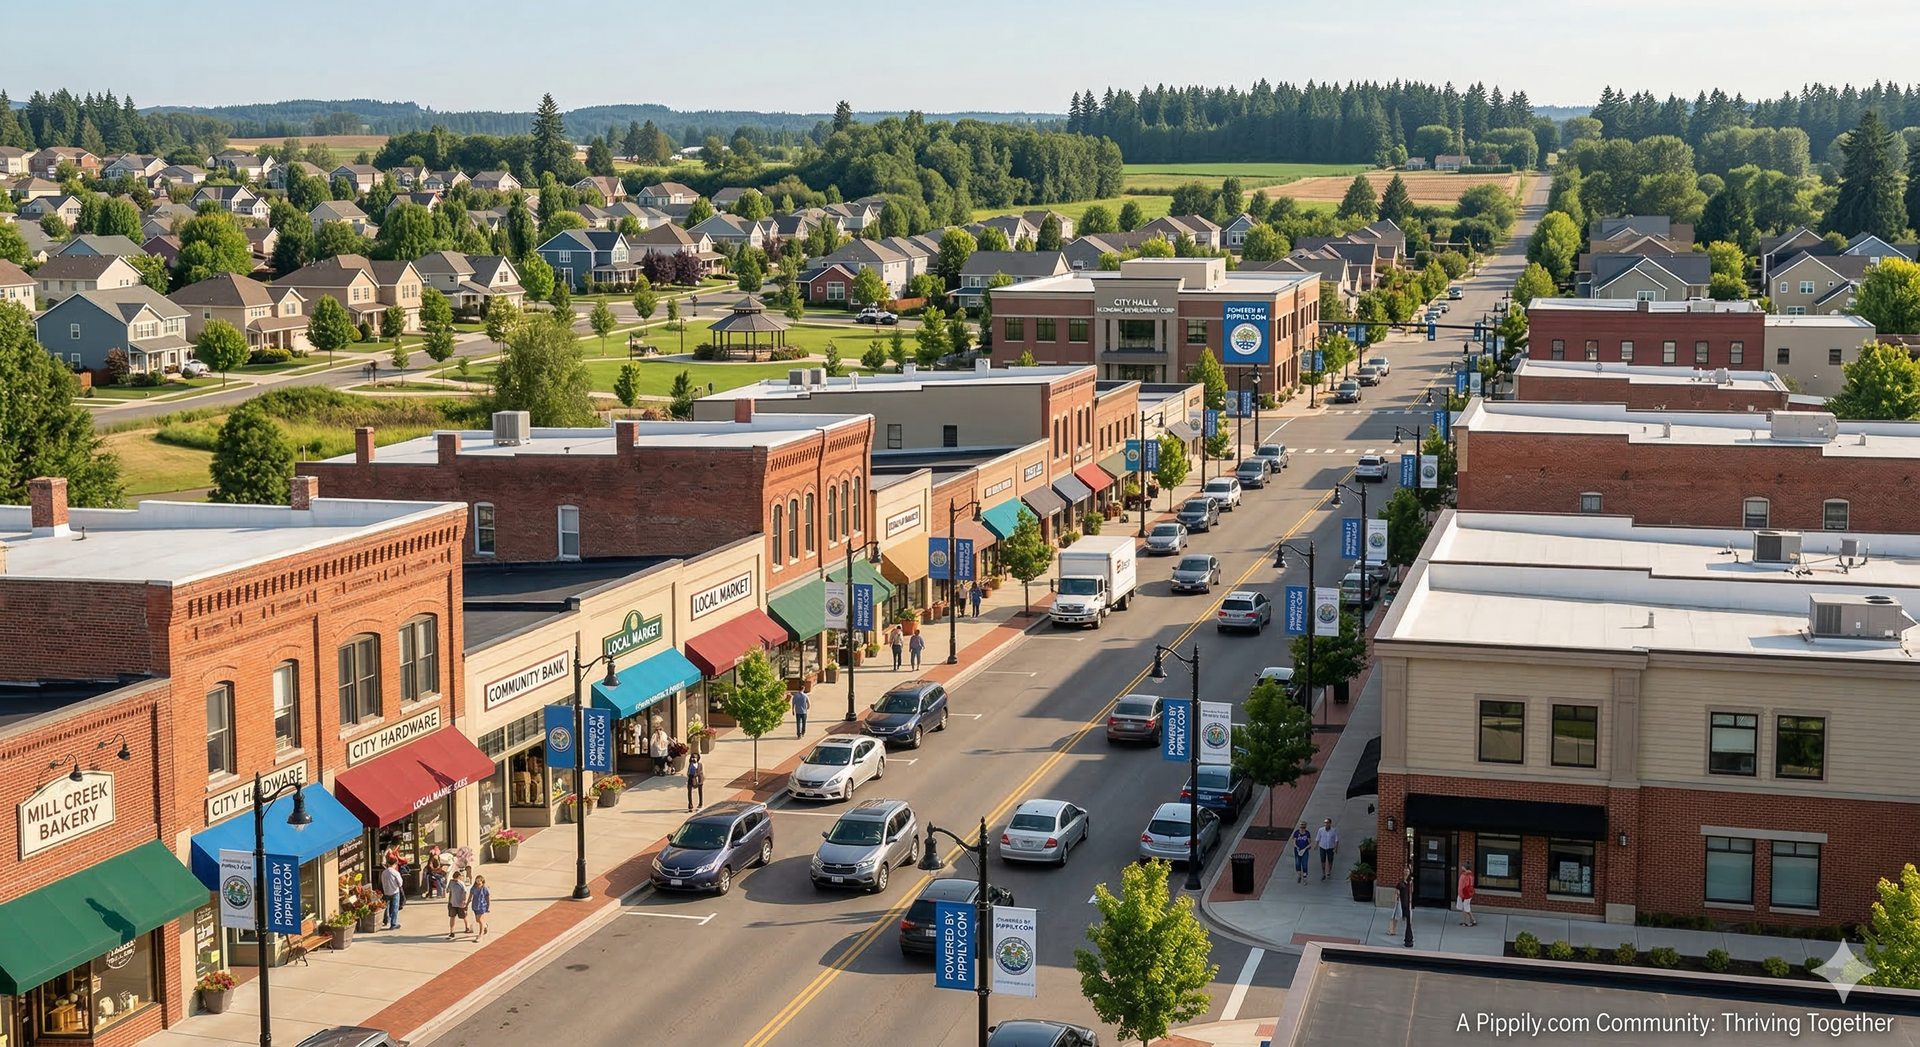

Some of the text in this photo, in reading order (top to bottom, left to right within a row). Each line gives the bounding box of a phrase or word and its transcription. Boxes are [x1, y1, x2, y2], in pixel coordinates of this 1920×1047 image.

[1113, 298, 1158, 306] CITY HALL &
[695, 577, 748, 613] LOCAL MARKET
[608, 634, 631, 655] LOCAL
[489, 657, 565, 702] COMMUNITY BANK
[589, 714, 596, 726] BY
[1168, 705, 1176, 716] BY
[353, 712, 437, 759] CITY HARDWARE
[28, 781, 108, 824] MILL CREEK
[212, 792, 239, 816] CITY
[413, 795, 433, 810] LOCAL
[40, 803, 98, 840] BAKERY
[273, 862, 282, 925] POWERED BY
[283, 863, 293, 926] PIPPILY.COM
[945, 911, 954, 980] POWERED BY
[957, 911, 967, 981] PIPPILY.COM
